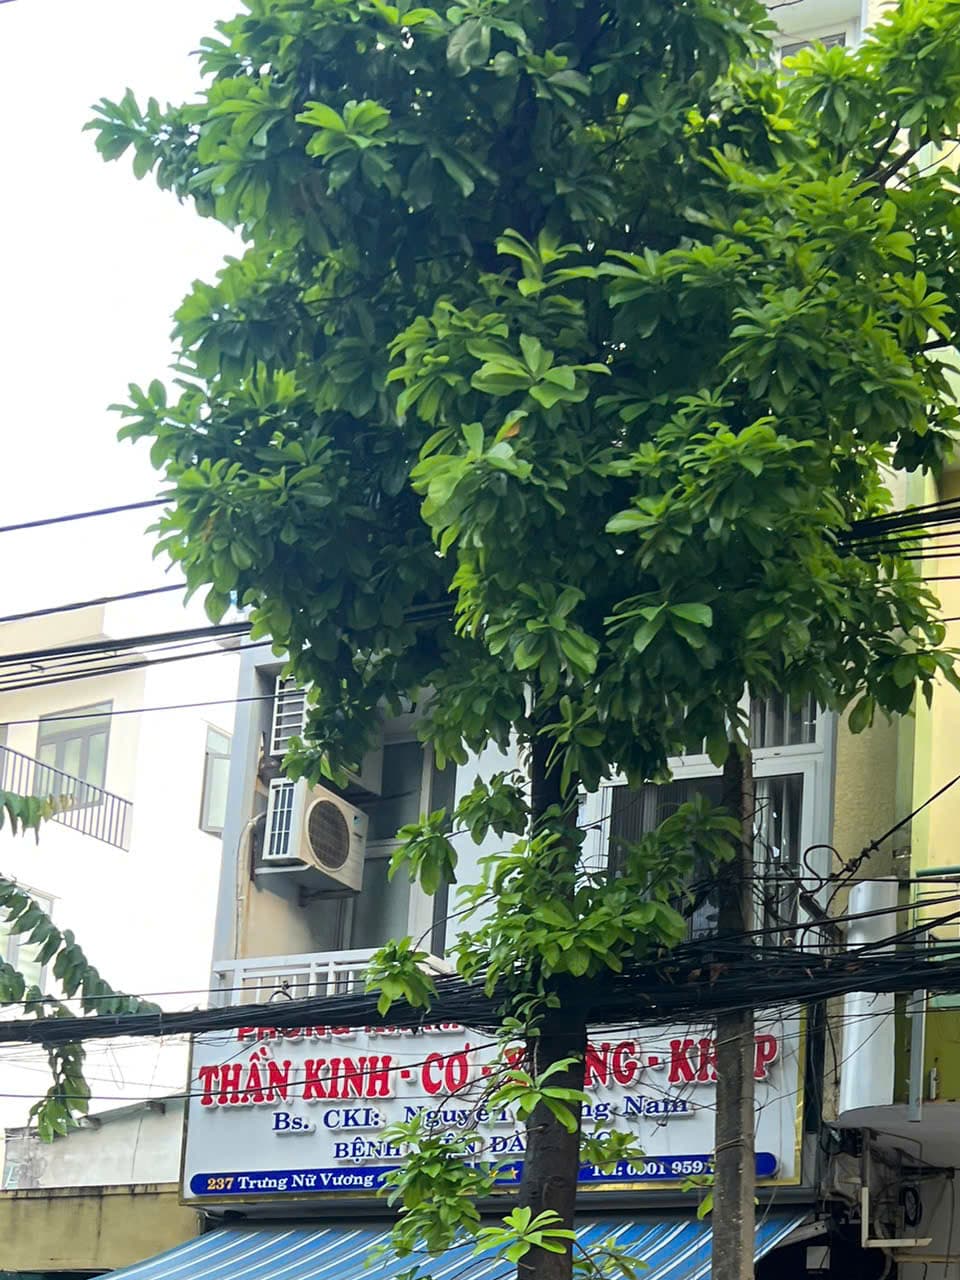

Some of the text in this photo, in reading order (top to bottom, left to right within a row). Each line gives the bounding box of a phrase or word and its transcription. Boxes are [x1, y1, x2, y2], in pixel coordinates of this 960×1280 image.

[199, 1046, 292, 1105] THẦN
[302, 1055, 392, 1100] KINH
[272, 1112, 310, 1130] Bs.
[623, 1095, 688, 1115] Nam
[207, 1177, 233, 1190] 237
[238, 1176, 287, 1191] Trưng
[291, 1173, 316, 1187] Nữ
[321, 1173, 374, 1188] Vương
[672, 1160, 703, 1174] 959
